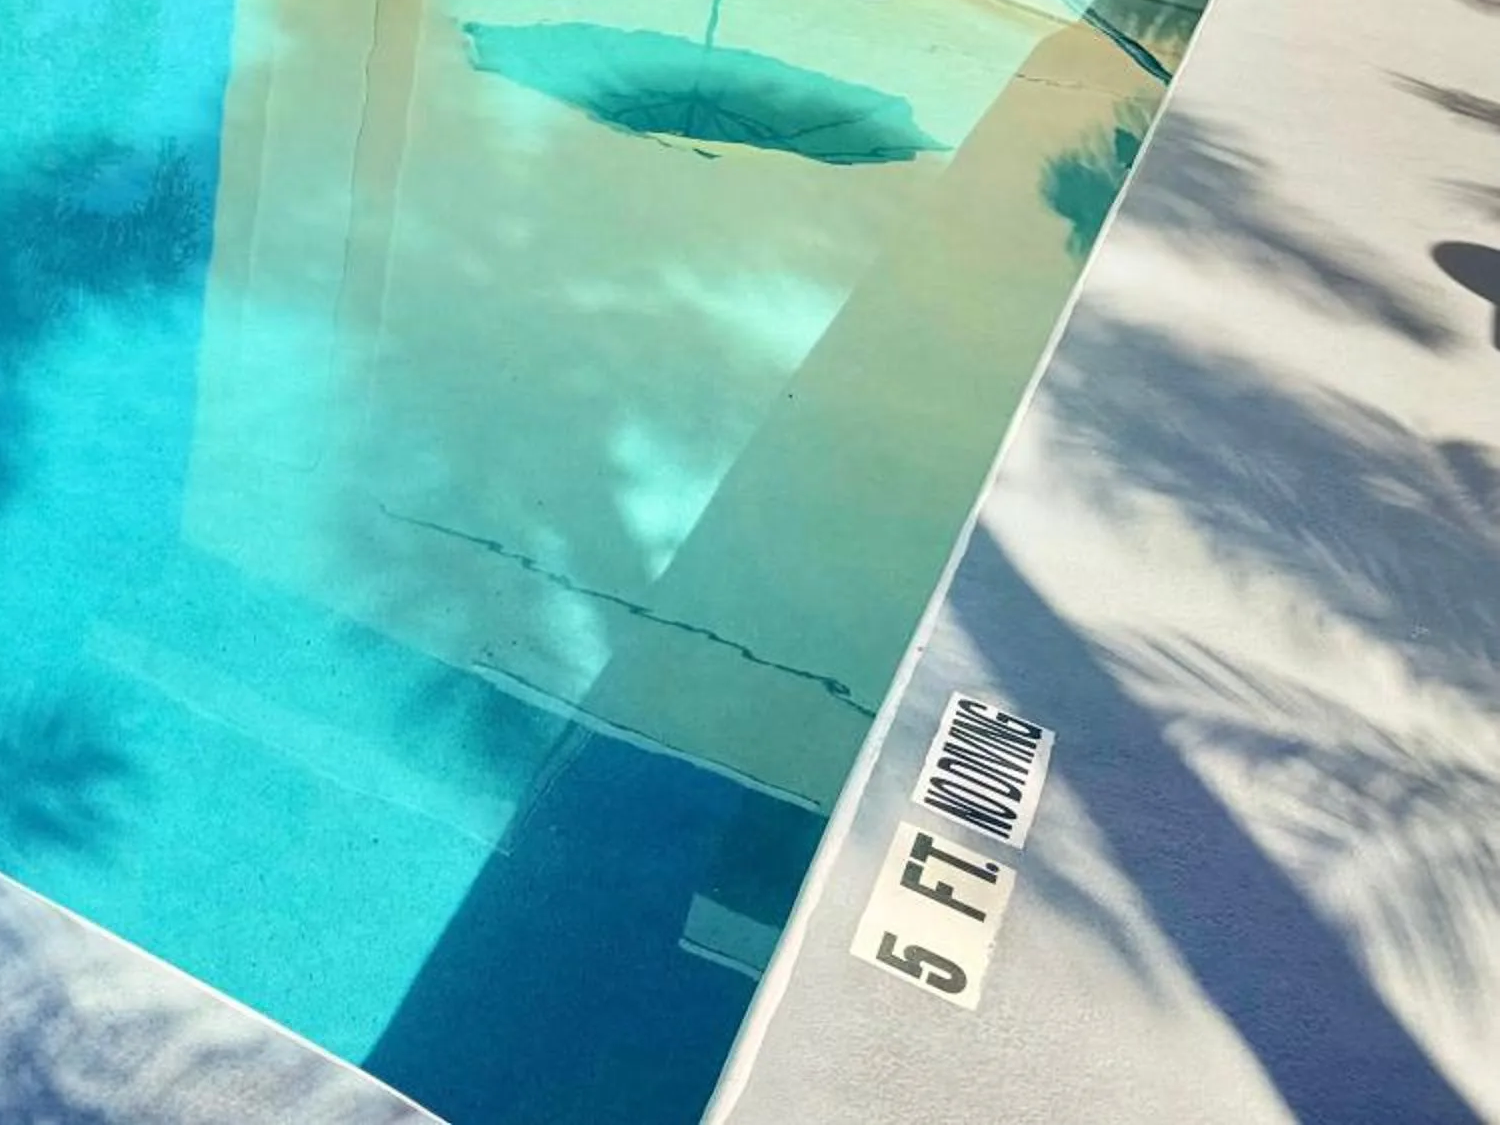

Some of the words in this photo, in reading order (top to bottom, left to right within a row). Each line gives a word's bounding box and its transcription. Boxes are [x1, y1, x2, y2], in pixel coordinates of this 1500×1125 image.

[937, 698, 1043, 804] DIVING
[924, 777, 1018, 839] NO
[900, 832, 1000, 923] FT.
[876, 931, 967, 994] 5
